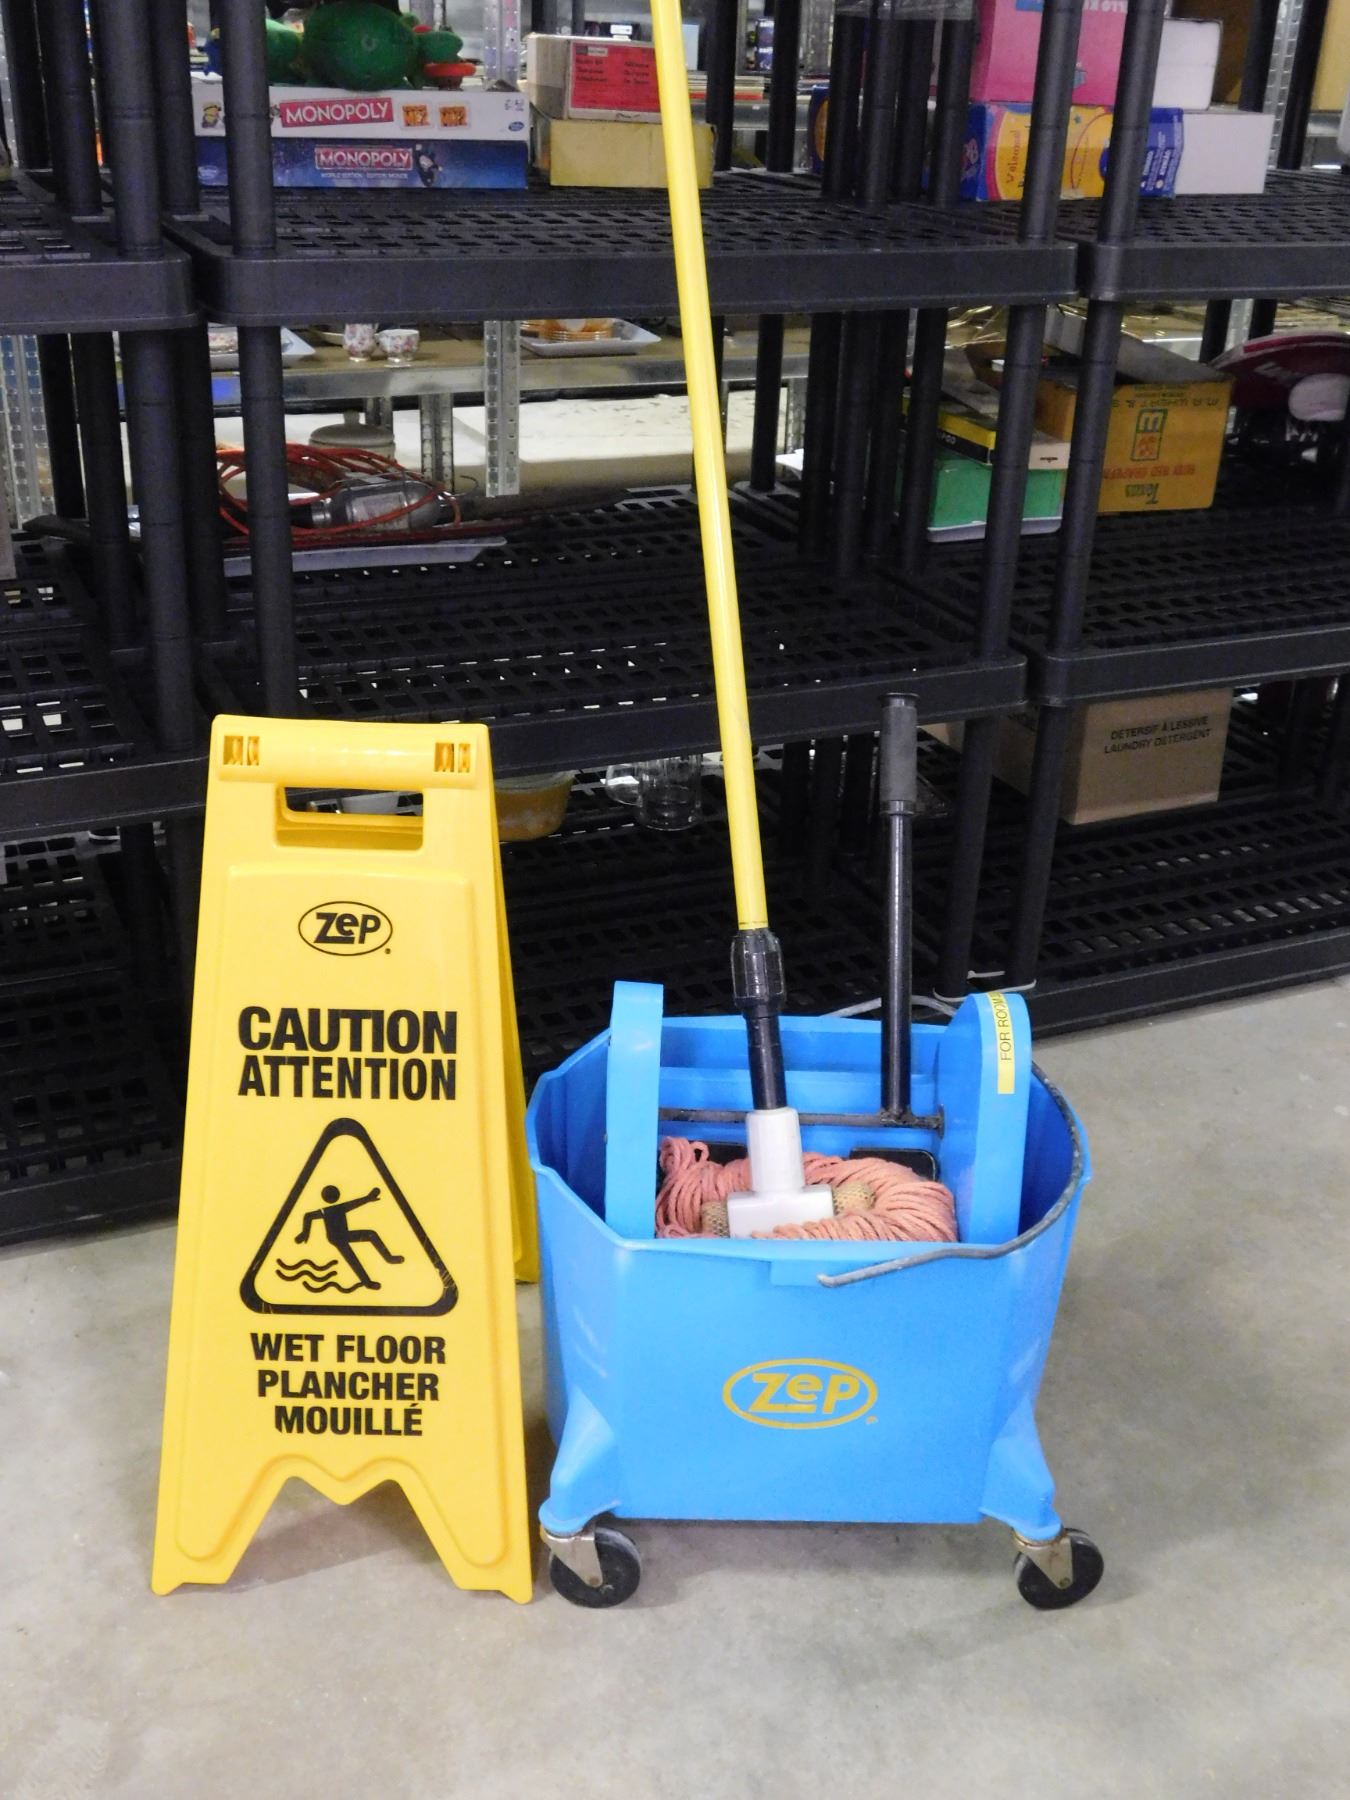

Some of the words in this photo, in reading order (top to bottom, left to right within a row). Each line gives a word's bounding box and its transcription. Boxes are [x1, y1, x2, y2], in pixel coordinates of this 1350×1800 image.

[285, 102, 390, 124] MONOPOLY
[319, 151, 410, 168] MONOPOLY
[1104, 738, 1152, 754] LAUNDRY
[1153, 728, 1213, 747] DETERGENT
[238, 1006, 458, 1054] CAUTION
[999, 1032, 1012, 1061] FOR
[238, 1055, 456, 1101] ATTENTION
[250, 1333, 324, 1362] WET
[336, 1335, 446, 1364] FLOOR
[258, 1370, 439, 1401] PLANCHER
[275, 1403, 422, 1436] MOUILLÉ
